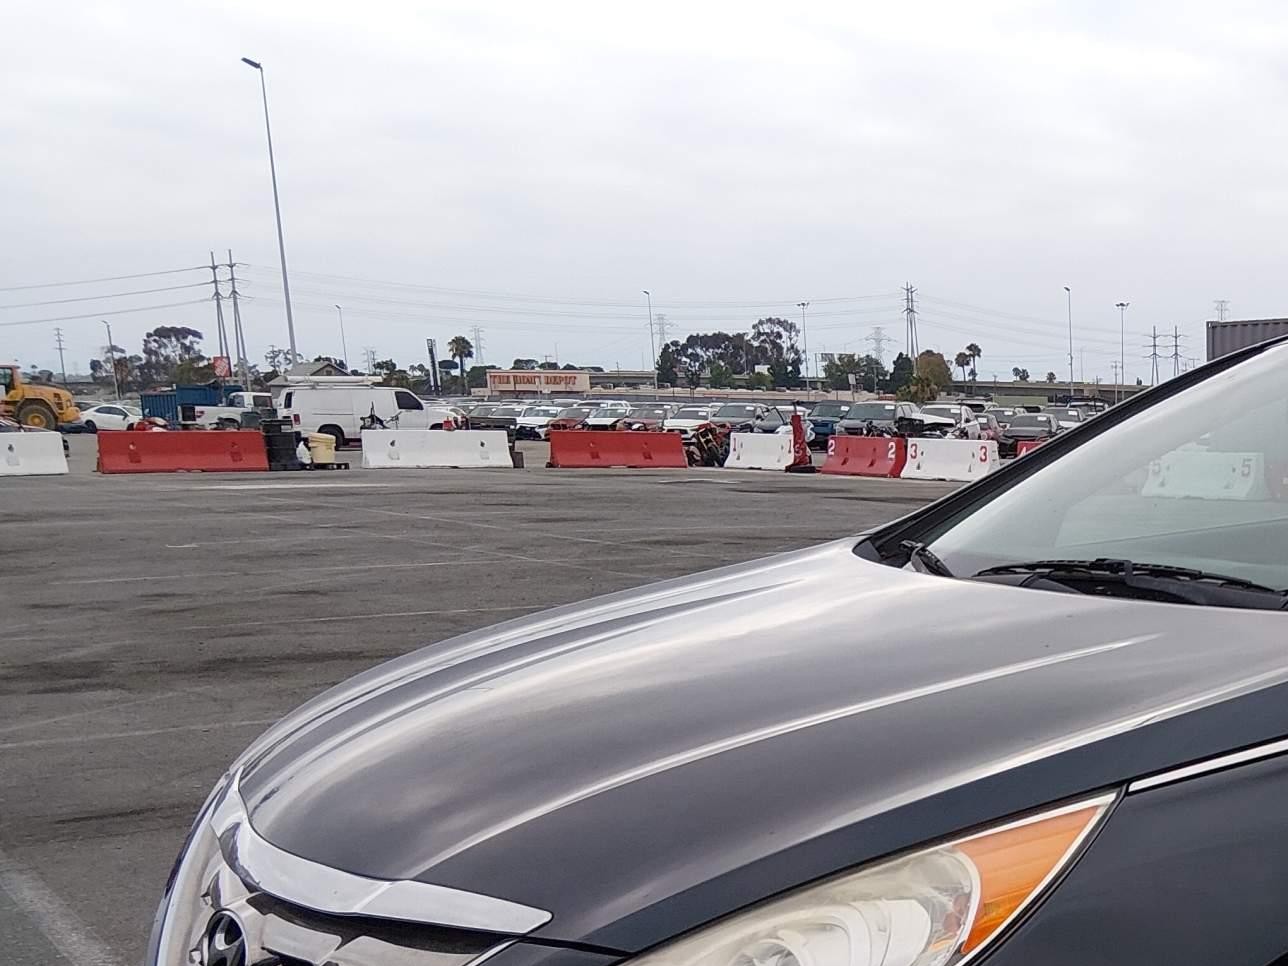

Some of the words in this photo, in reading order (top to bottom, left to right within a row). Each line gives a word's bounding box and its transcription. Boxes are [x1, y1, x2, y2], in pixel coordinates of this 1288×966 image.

[732, 437, 738, 453] 1
[827, 440, 836, 456] 2
[887, 441, 896, 458] 2
[910, 443, 918, 459] 3
[979, 445, 988, 462] 3
[1241, 458, 1253, 477] 5
